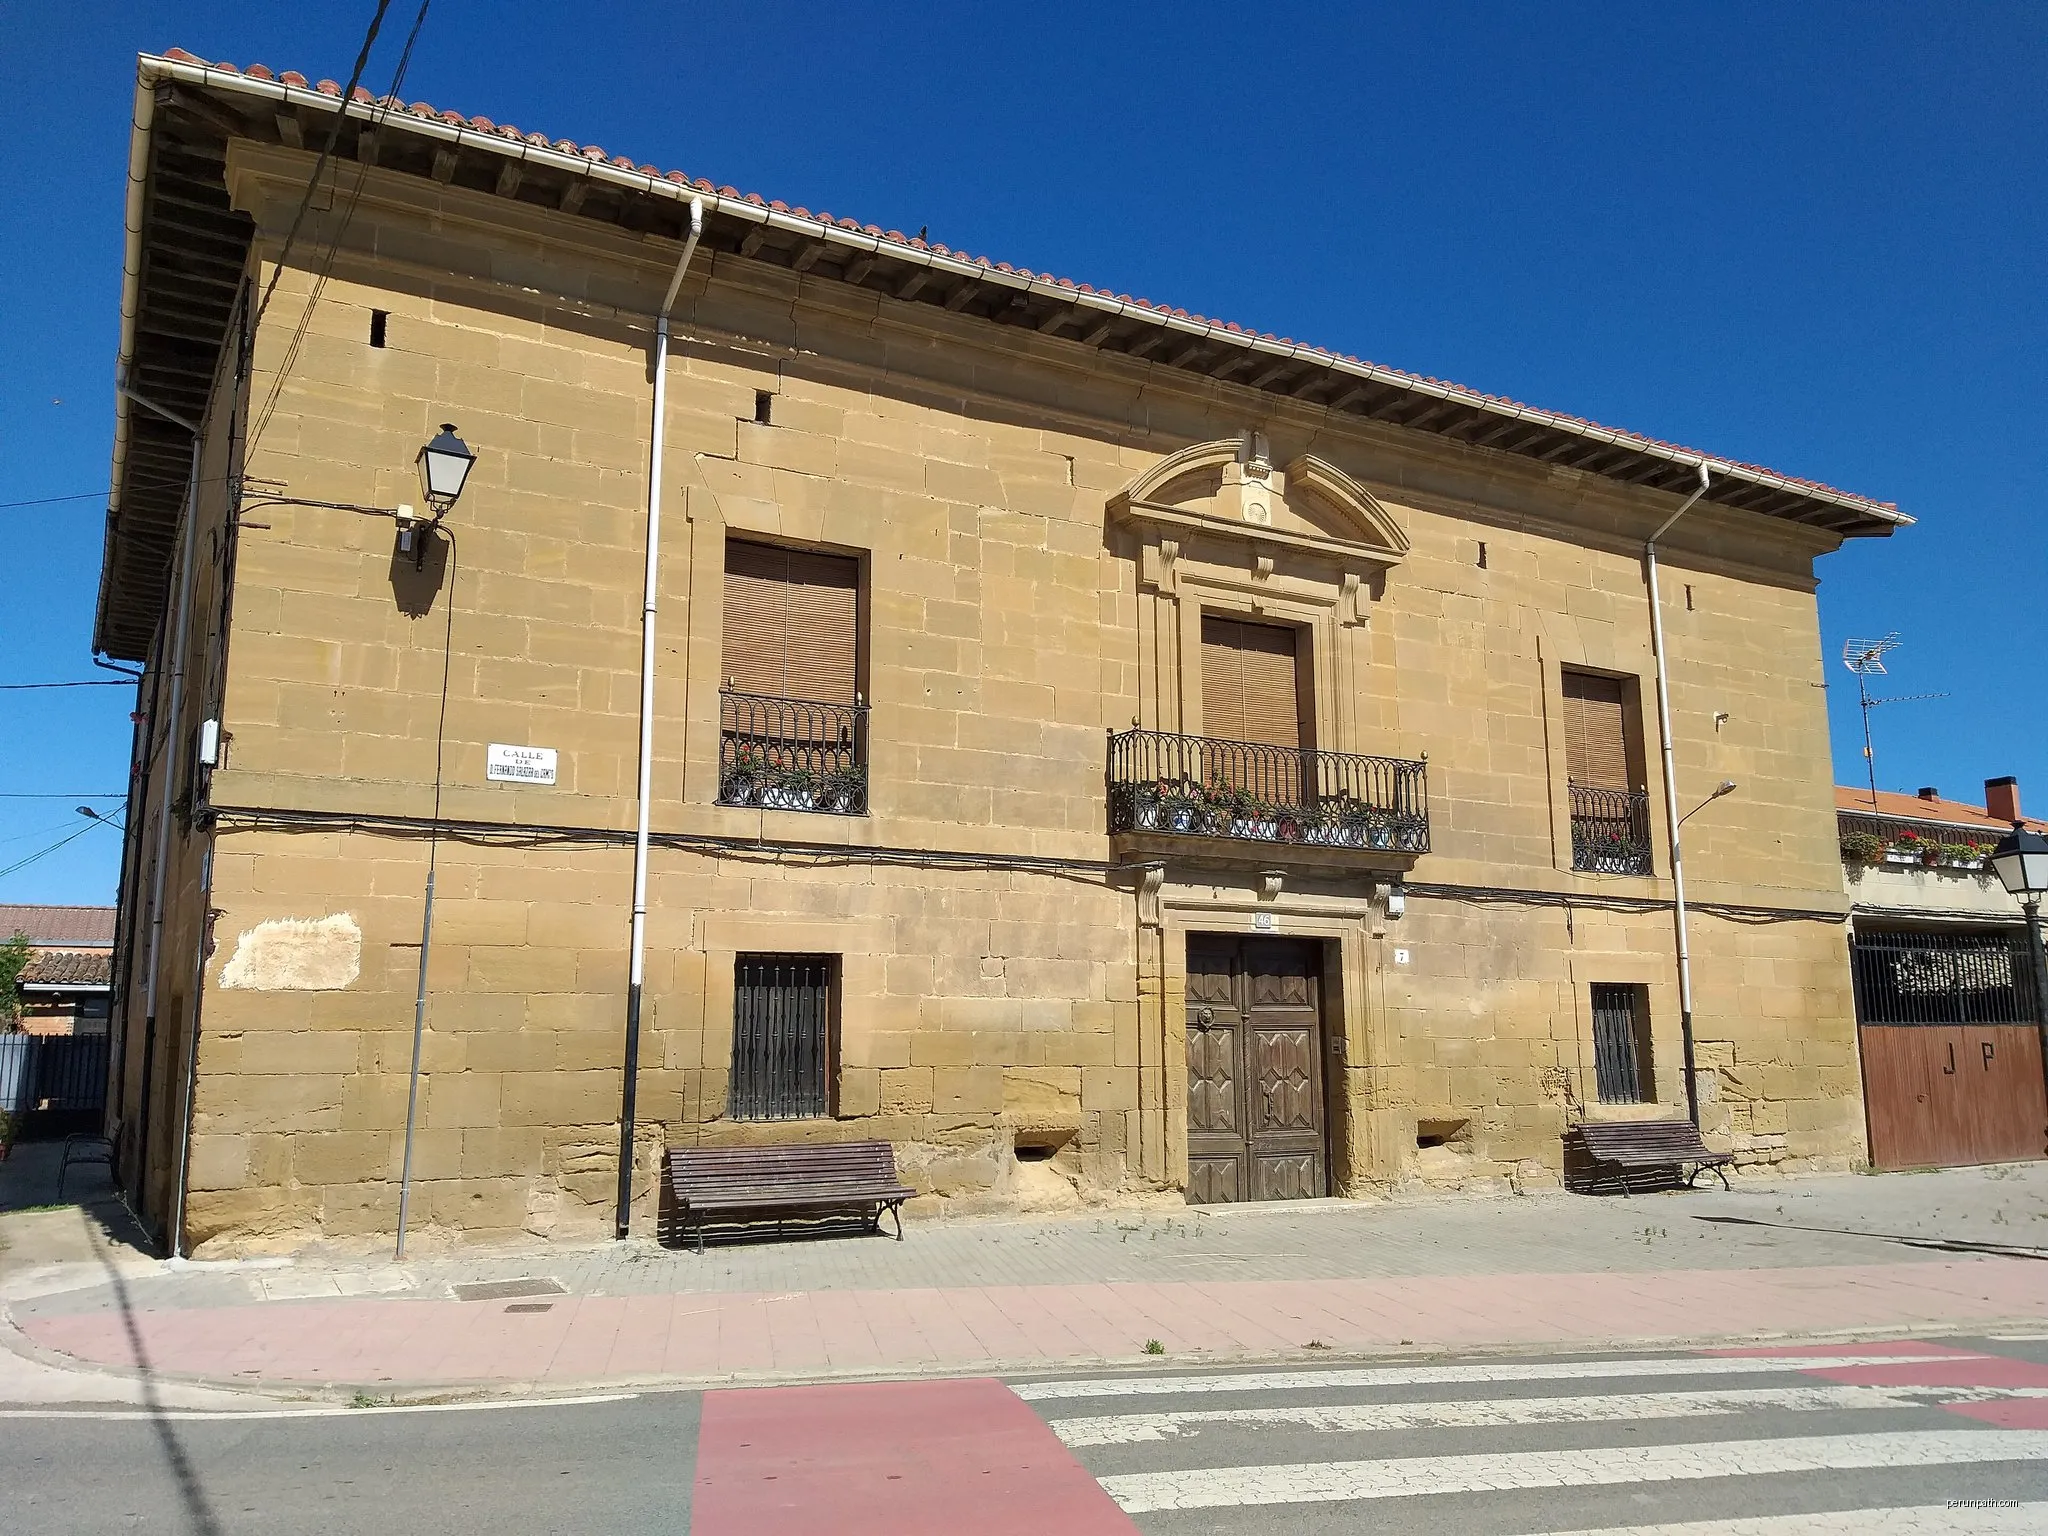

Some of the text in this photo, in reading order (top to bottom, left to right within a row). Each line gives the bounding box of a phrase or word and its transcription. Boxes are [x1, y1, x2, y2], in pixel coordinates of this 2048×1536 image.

[503, 749, 543, 760] CALLE
[1258, 914, 1270, 926] 46
[1943, 1042, 1995, 1075] J P
